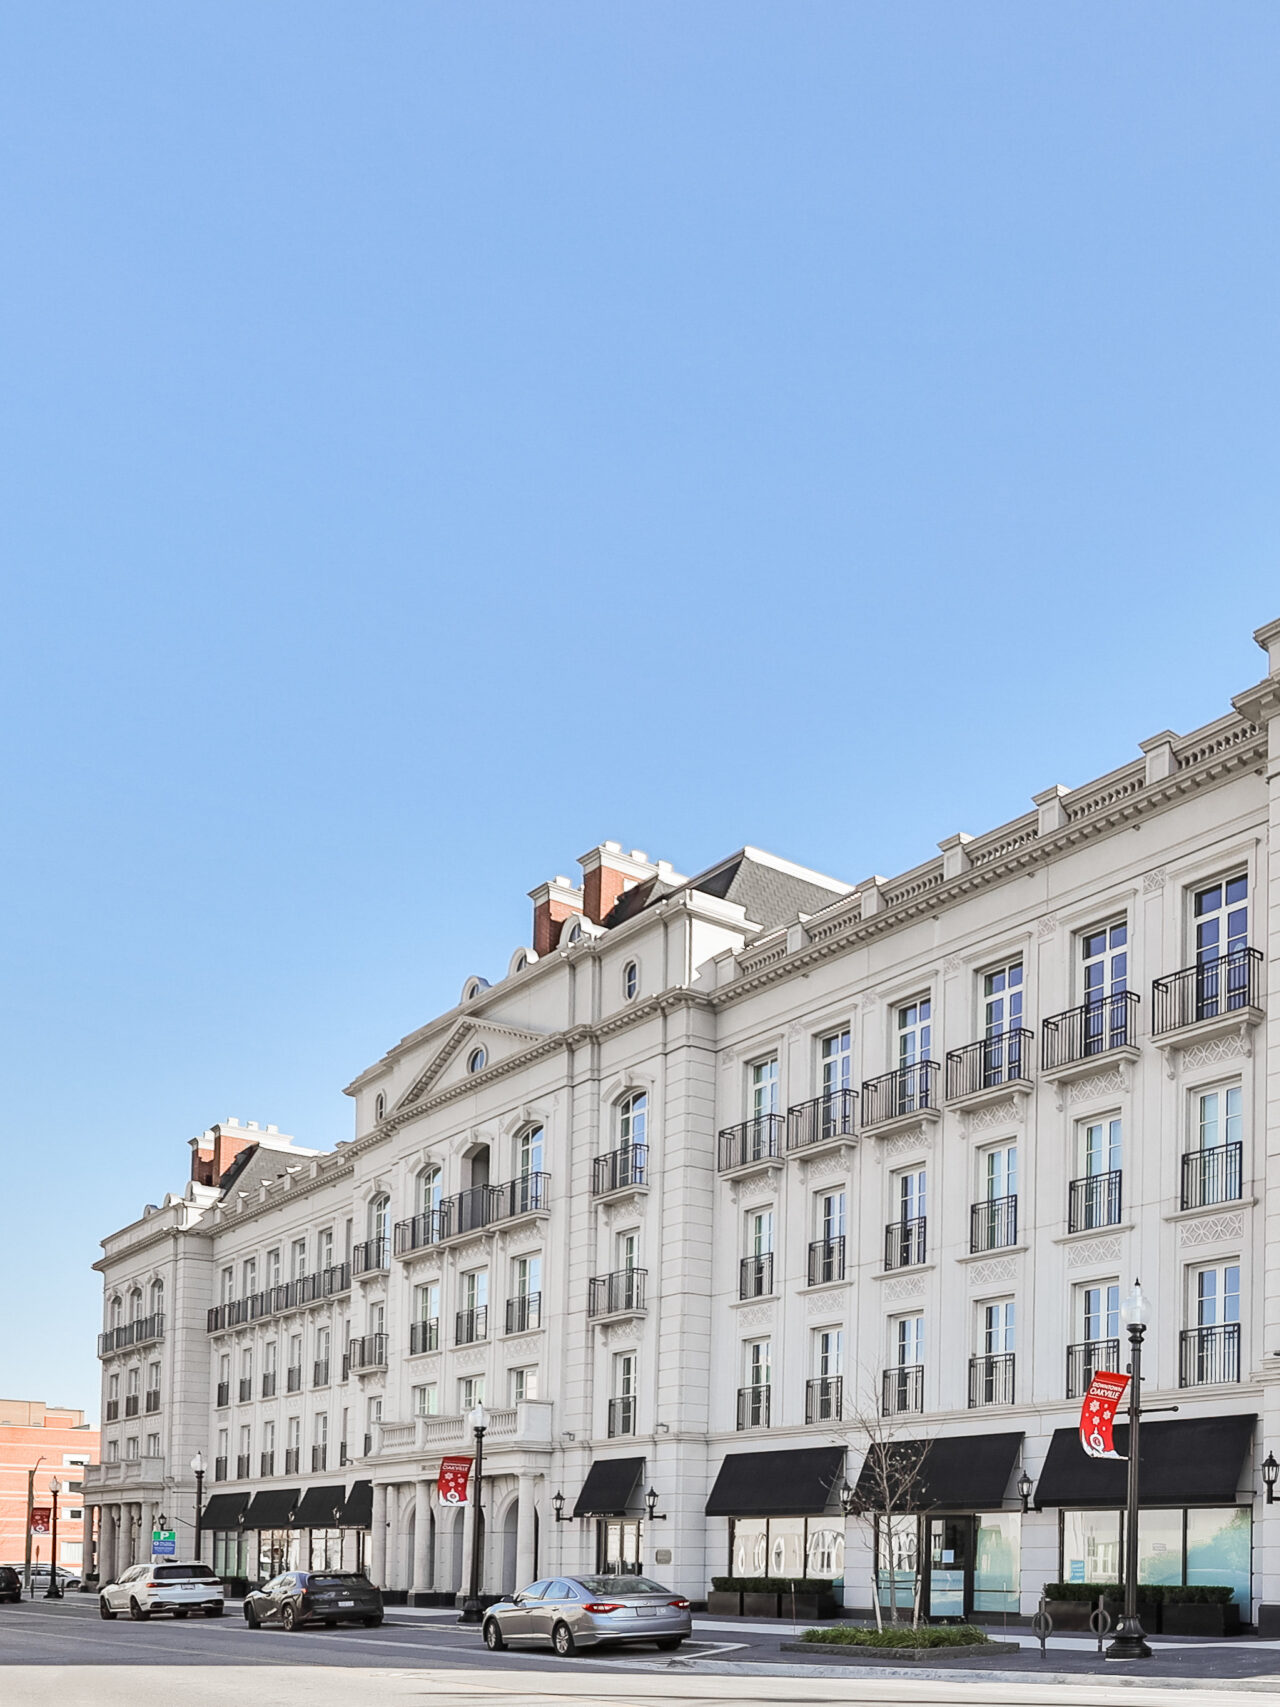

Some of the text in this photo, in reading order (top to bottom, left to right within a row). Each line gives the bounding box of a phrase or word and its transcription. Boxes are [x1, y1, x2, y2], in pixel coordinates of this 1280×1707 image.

[1092, 1382, 1123, 1392] DOWNTOWN
[1090, 1387, 1121, 1399] OAKVILLE
[160, 1531, 170, 1540] P
